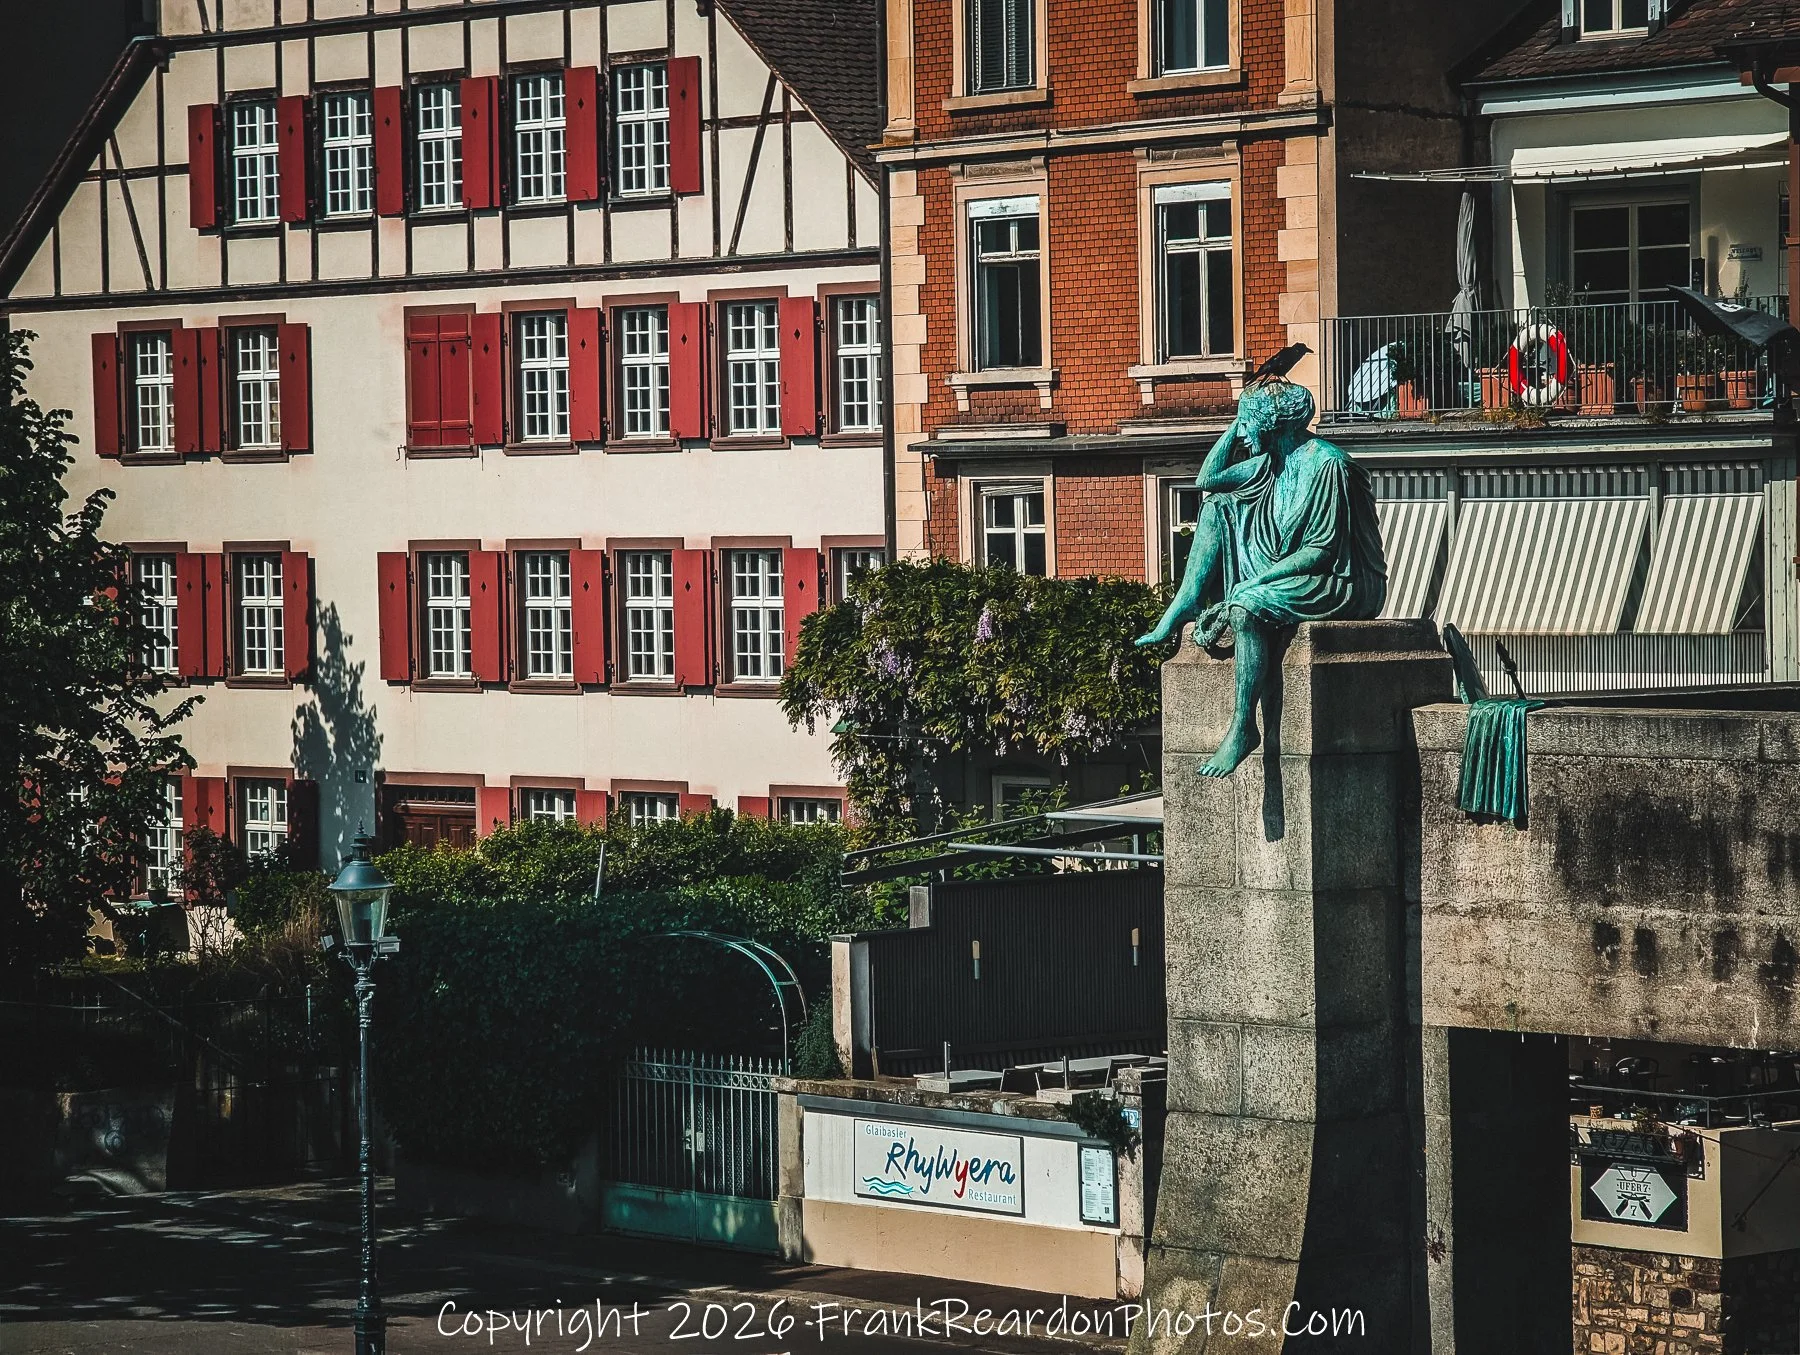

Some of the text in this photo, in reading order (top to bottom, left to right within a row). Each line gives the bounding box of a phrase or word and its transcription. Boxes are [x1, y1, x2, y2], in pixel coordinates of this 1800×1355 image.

[865, 1124, 907, 1139] Glaibasler
[884, 1136, 1016, 1199] RhyWyera
[968, 1188, 1017, 1206] Restaurant
[1630, 1205, 1637, 1217] 7
